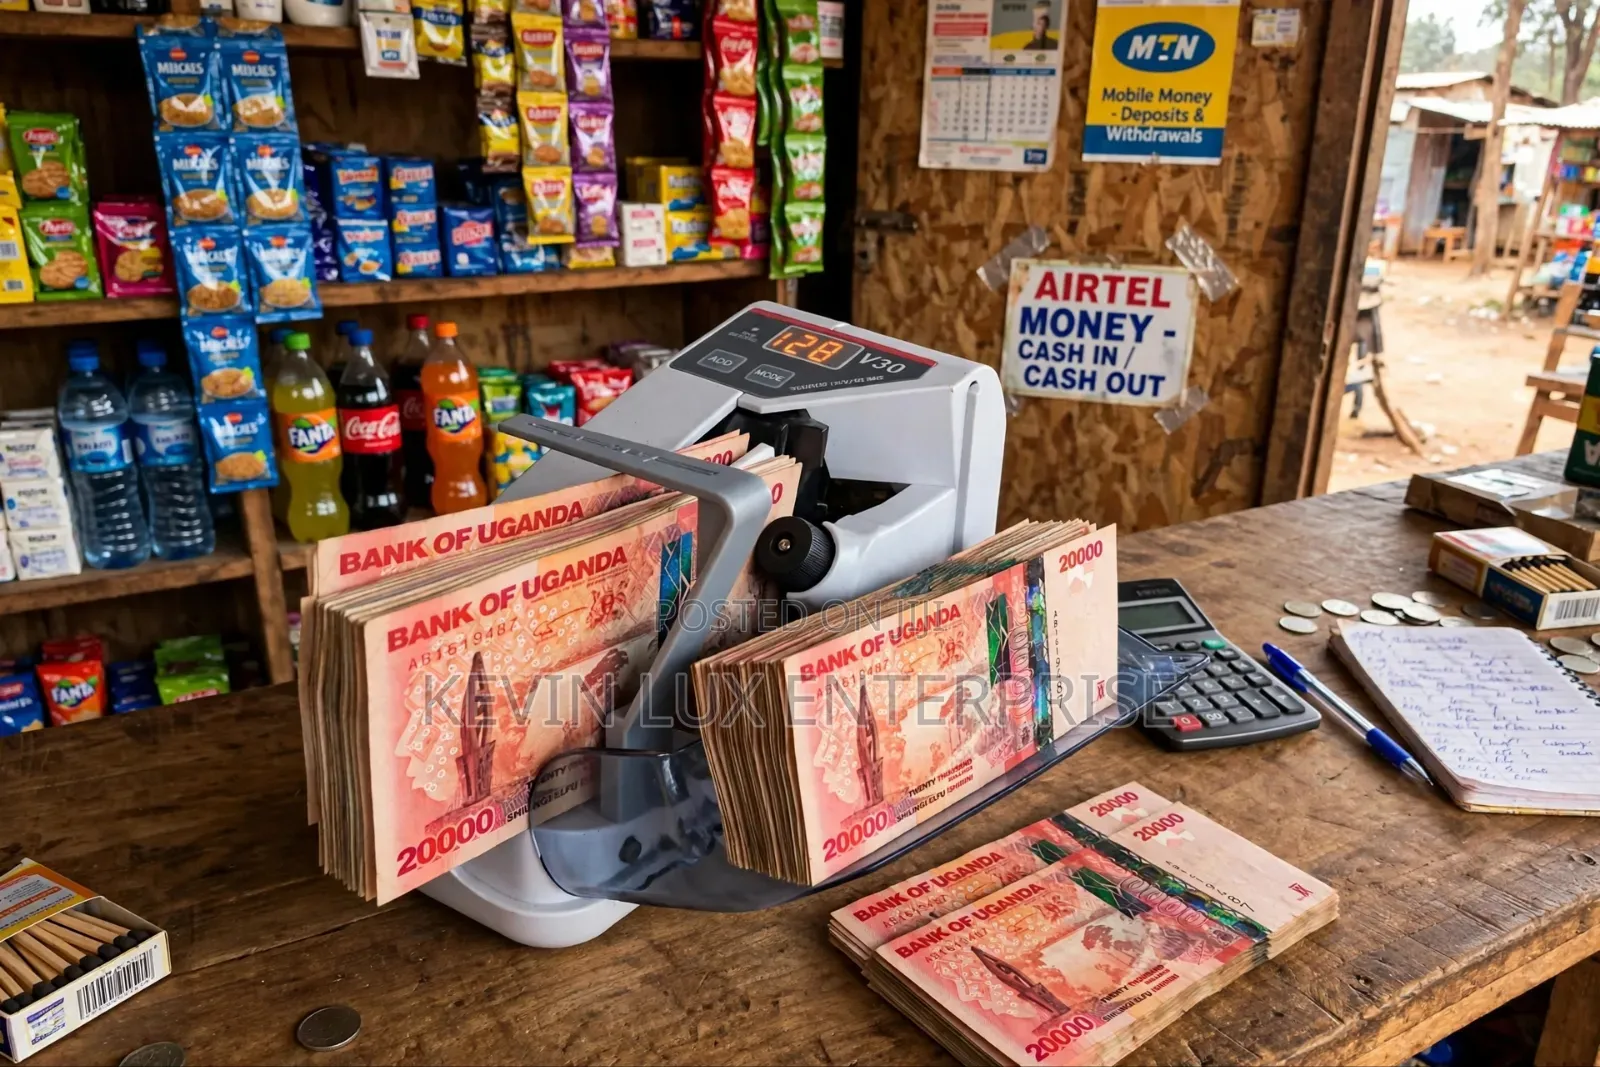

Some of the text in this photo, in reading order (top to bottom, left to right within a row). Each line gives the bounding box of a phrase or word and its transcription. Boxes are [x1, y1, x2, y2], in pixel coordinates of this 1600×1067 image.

[1127, 34, 1200, 61] MTN
[1102, 87, 1212, 107] Mobile Money
[1120, 106, 1189, 125] Deposits
[1193, 107, 1204, 122] &
[1106, 126, 1203, 144] Withdrawals
[1034, 271, 1171, 308] AIRTEL
[1018, 306, 1154, 343] MONEY
[707, 354, 733, 366] ADD
[771, 332, 843, 362] 128
[1018, 339, 1084, 364] CASH
[1093, 345, 1118, 366] IN
[754, 368, 785, 382] MODE
[857, 352, 907, 374] V30
[1023, 365, 1166, 397] CASH OUT
[433, 405, 476, 426] FANTA
[288, 422, 335, 446] FANTA
[340, 501, 584, 576] BANK OF UGANDA
[1059, 540, 1104, 573] 20000
[387, 546, 628, 652] BANK OF UGANDA
[800, 604, 961, 683] BANK OF UGANDA
[908, 777, 936, 797] TWENTY
[1089, 791, 1139, 818] 20000
[822, 811, 888, 863] 20000
[1133, 812, 1185, 842] 20000
[397, 808, 494, 878] 20000
[853, 851, 1006, 922] BANK OF UGANDA
[894, 883, 1046, 959] BANK OF UGANDA
[1025, 1015, 1094, 1063] 20000
